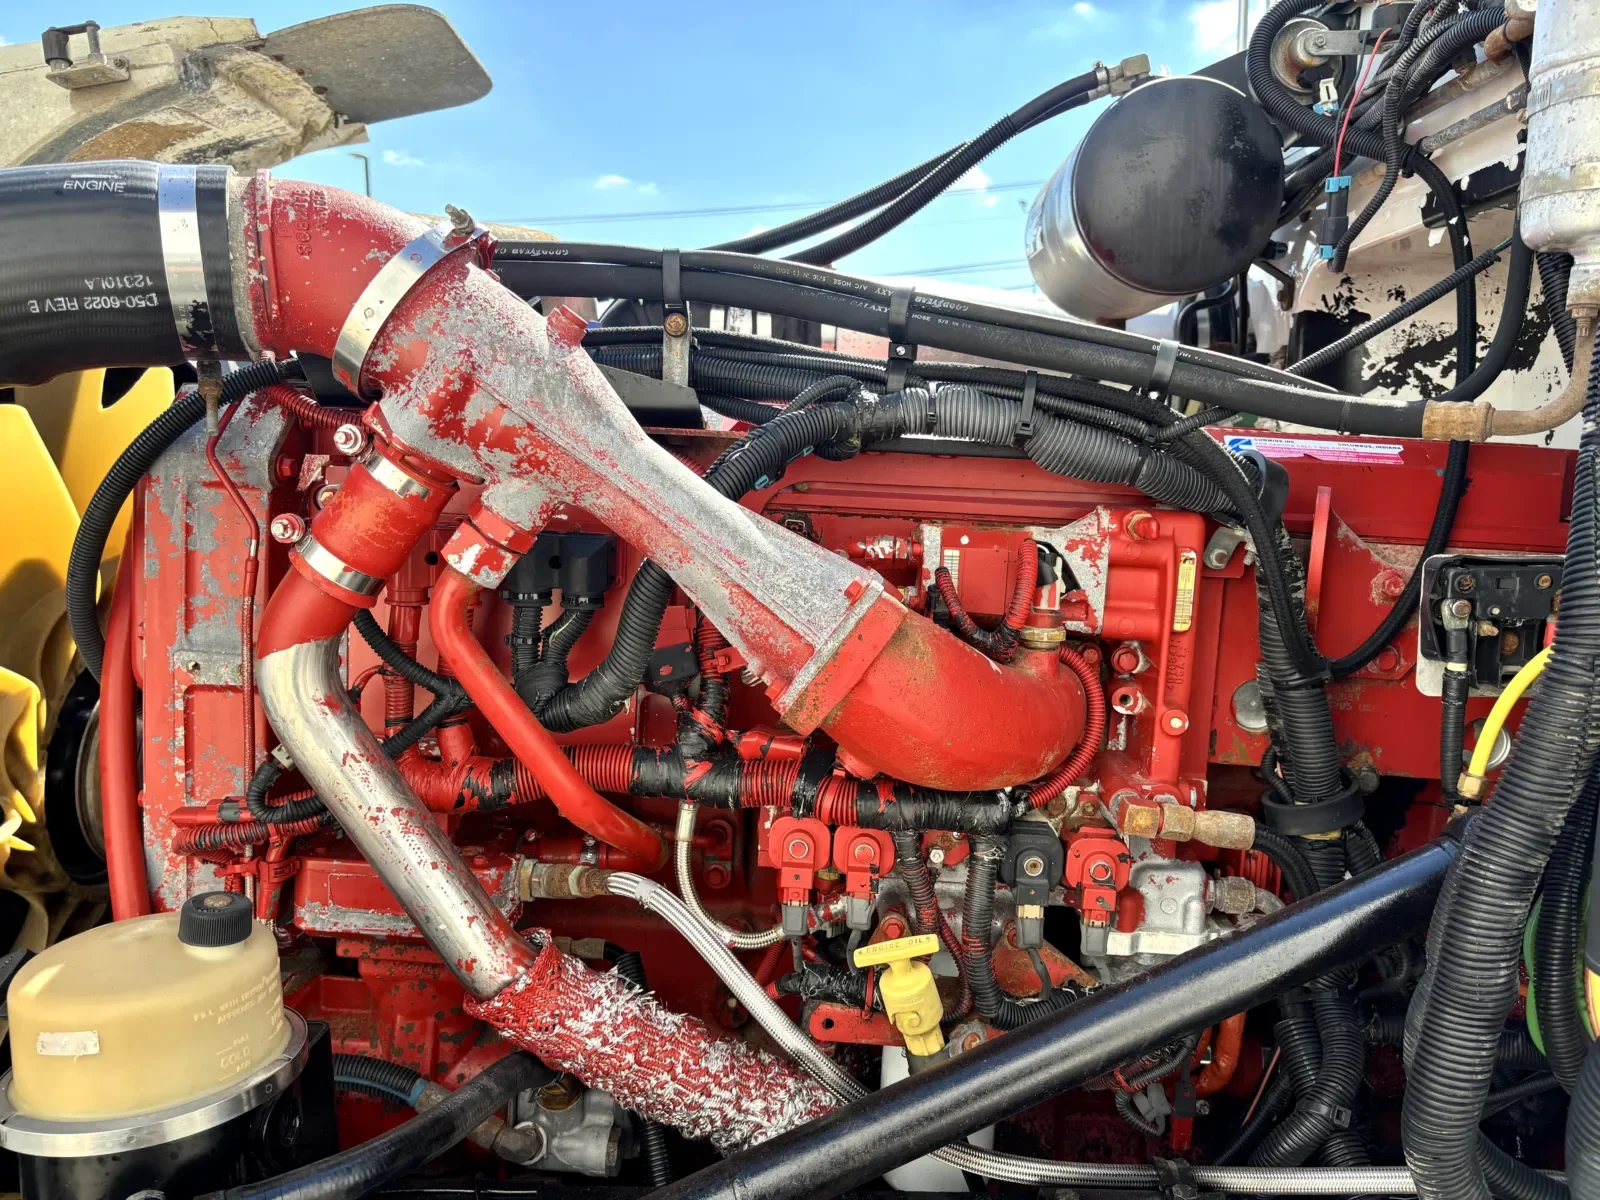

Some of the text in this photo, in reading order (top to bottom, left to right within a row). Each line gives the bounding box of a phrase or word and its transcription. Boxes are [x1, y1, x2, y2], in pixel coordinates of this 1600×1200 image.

[63, 180, 127, 193] ENGINE
[511, 247, 569, 257] GOODYEAR
[833, 278, 851, 287] HOSE
[854, 283, 868, 291] A/C
[874, 287, 895, 297] AXY
[28, 292, 159, 314] D50-6022 REV B
[914, 295, 969, 312] GOODYEAR
[911, 313, 932, 322] HOSE
[866, 938, 924, 954] ENGINE OIL
[220, 1046, 251, 1069] COLD
